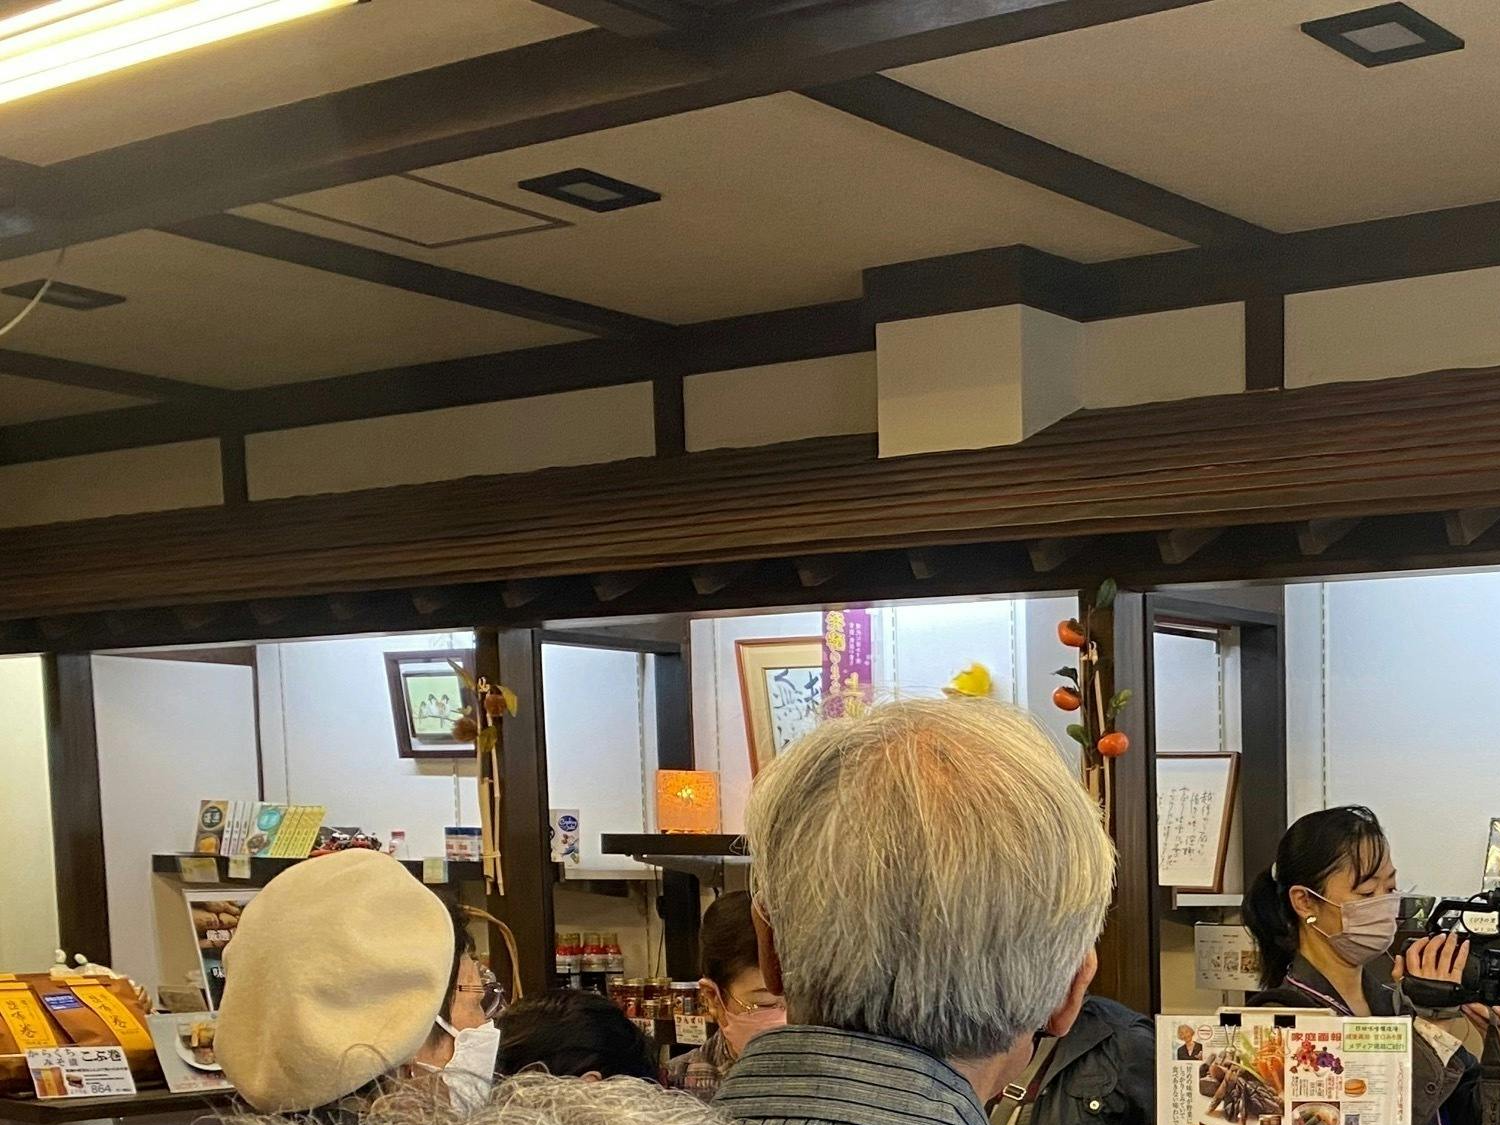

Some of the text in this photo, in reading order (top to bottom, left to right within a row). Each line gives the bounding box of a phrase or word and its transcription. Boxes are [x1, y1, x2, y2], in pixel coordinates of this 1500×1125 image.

[1291, 1032, 1342, 1042] 家庭画報
[81, 1049, 122, 1062] こぶ巻
[91, 1084, 112, 1093] 864
